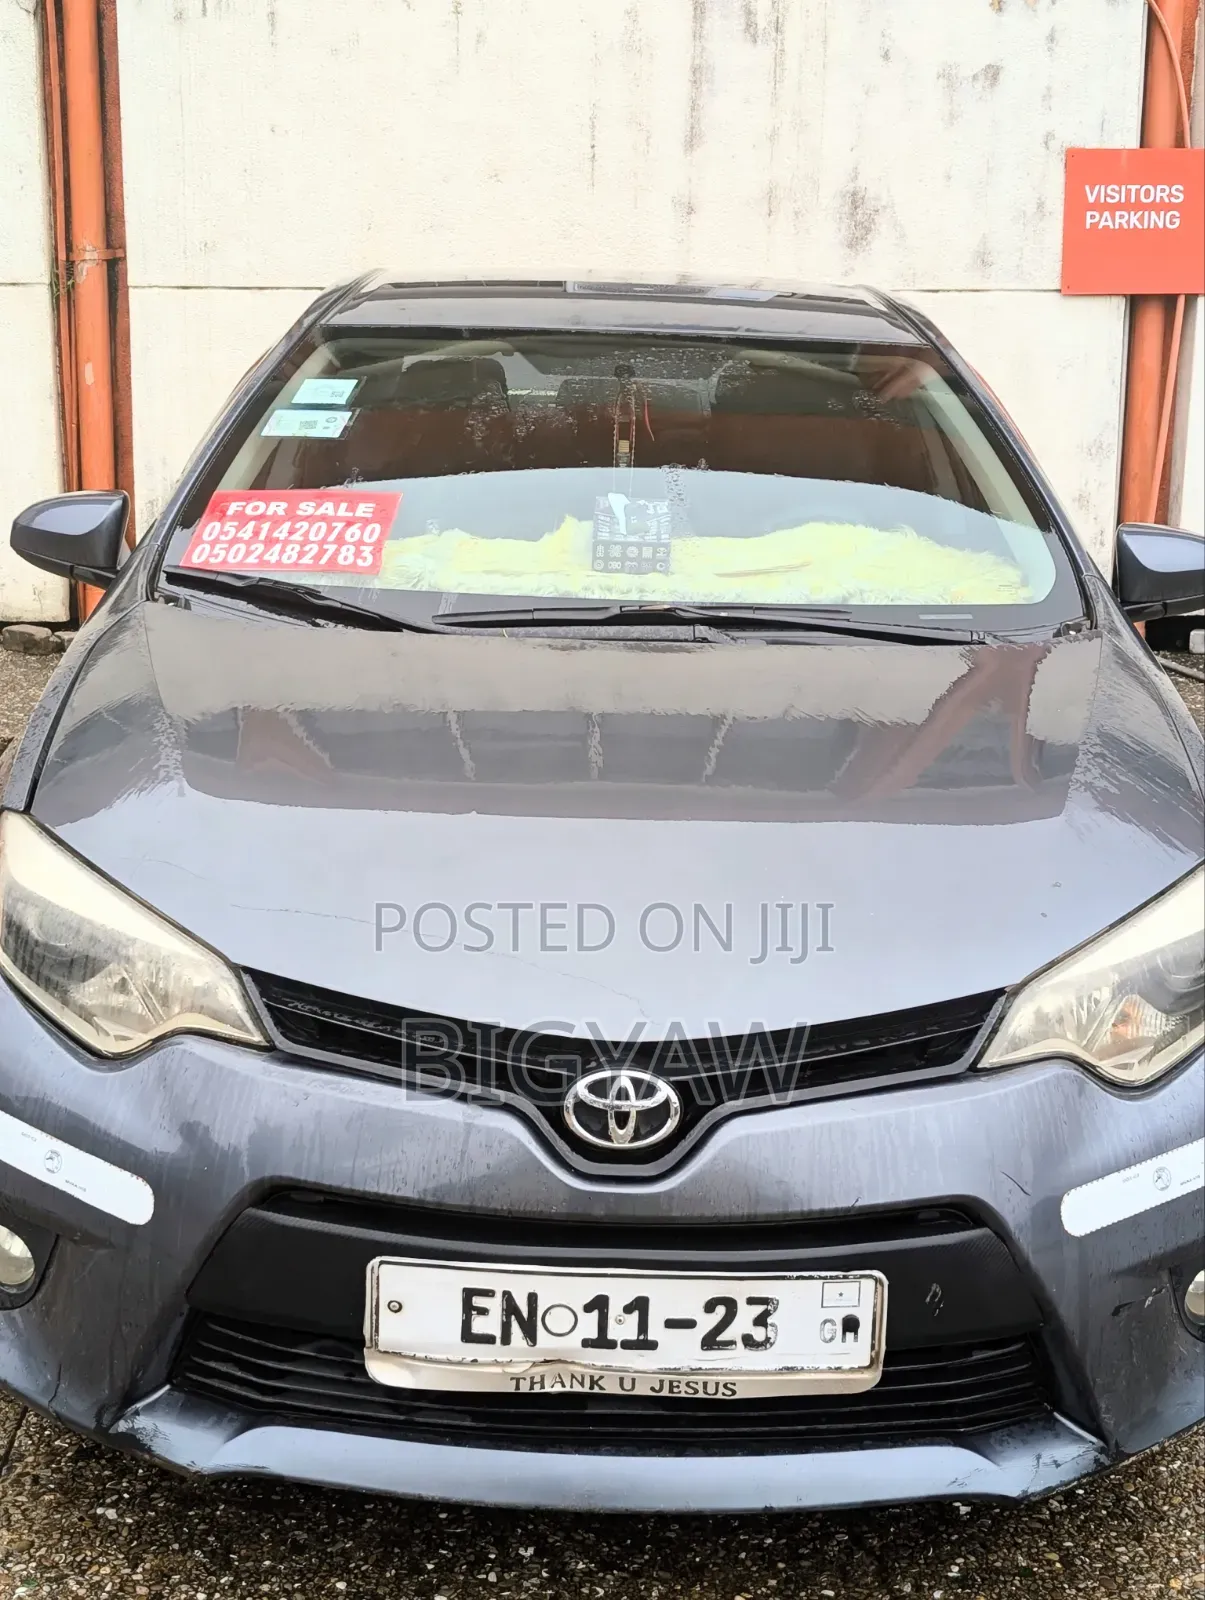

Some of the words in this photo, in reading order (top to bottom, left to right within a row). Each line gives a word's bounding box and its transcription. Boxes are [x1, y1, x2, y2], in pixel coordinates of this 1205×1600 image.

[1084, 184, 1185, 203] VISITORS
[1085, 210, 1181, 229] PARKING
[226, 501, 288, 517] FOR
[295, 501, 376, 518] SALE
[202, 521, 382, 543] 0541420760
[191, 543, 375, 568] 0502482783
[460, 1287, 538, 1347] EN
[581, 1293, 780, 1351] 11-23
[510, 1373, 606, 1392] THANK
[618, 1376, 637, 1392] U
[649, 1377, 738, 1397] JESUS
